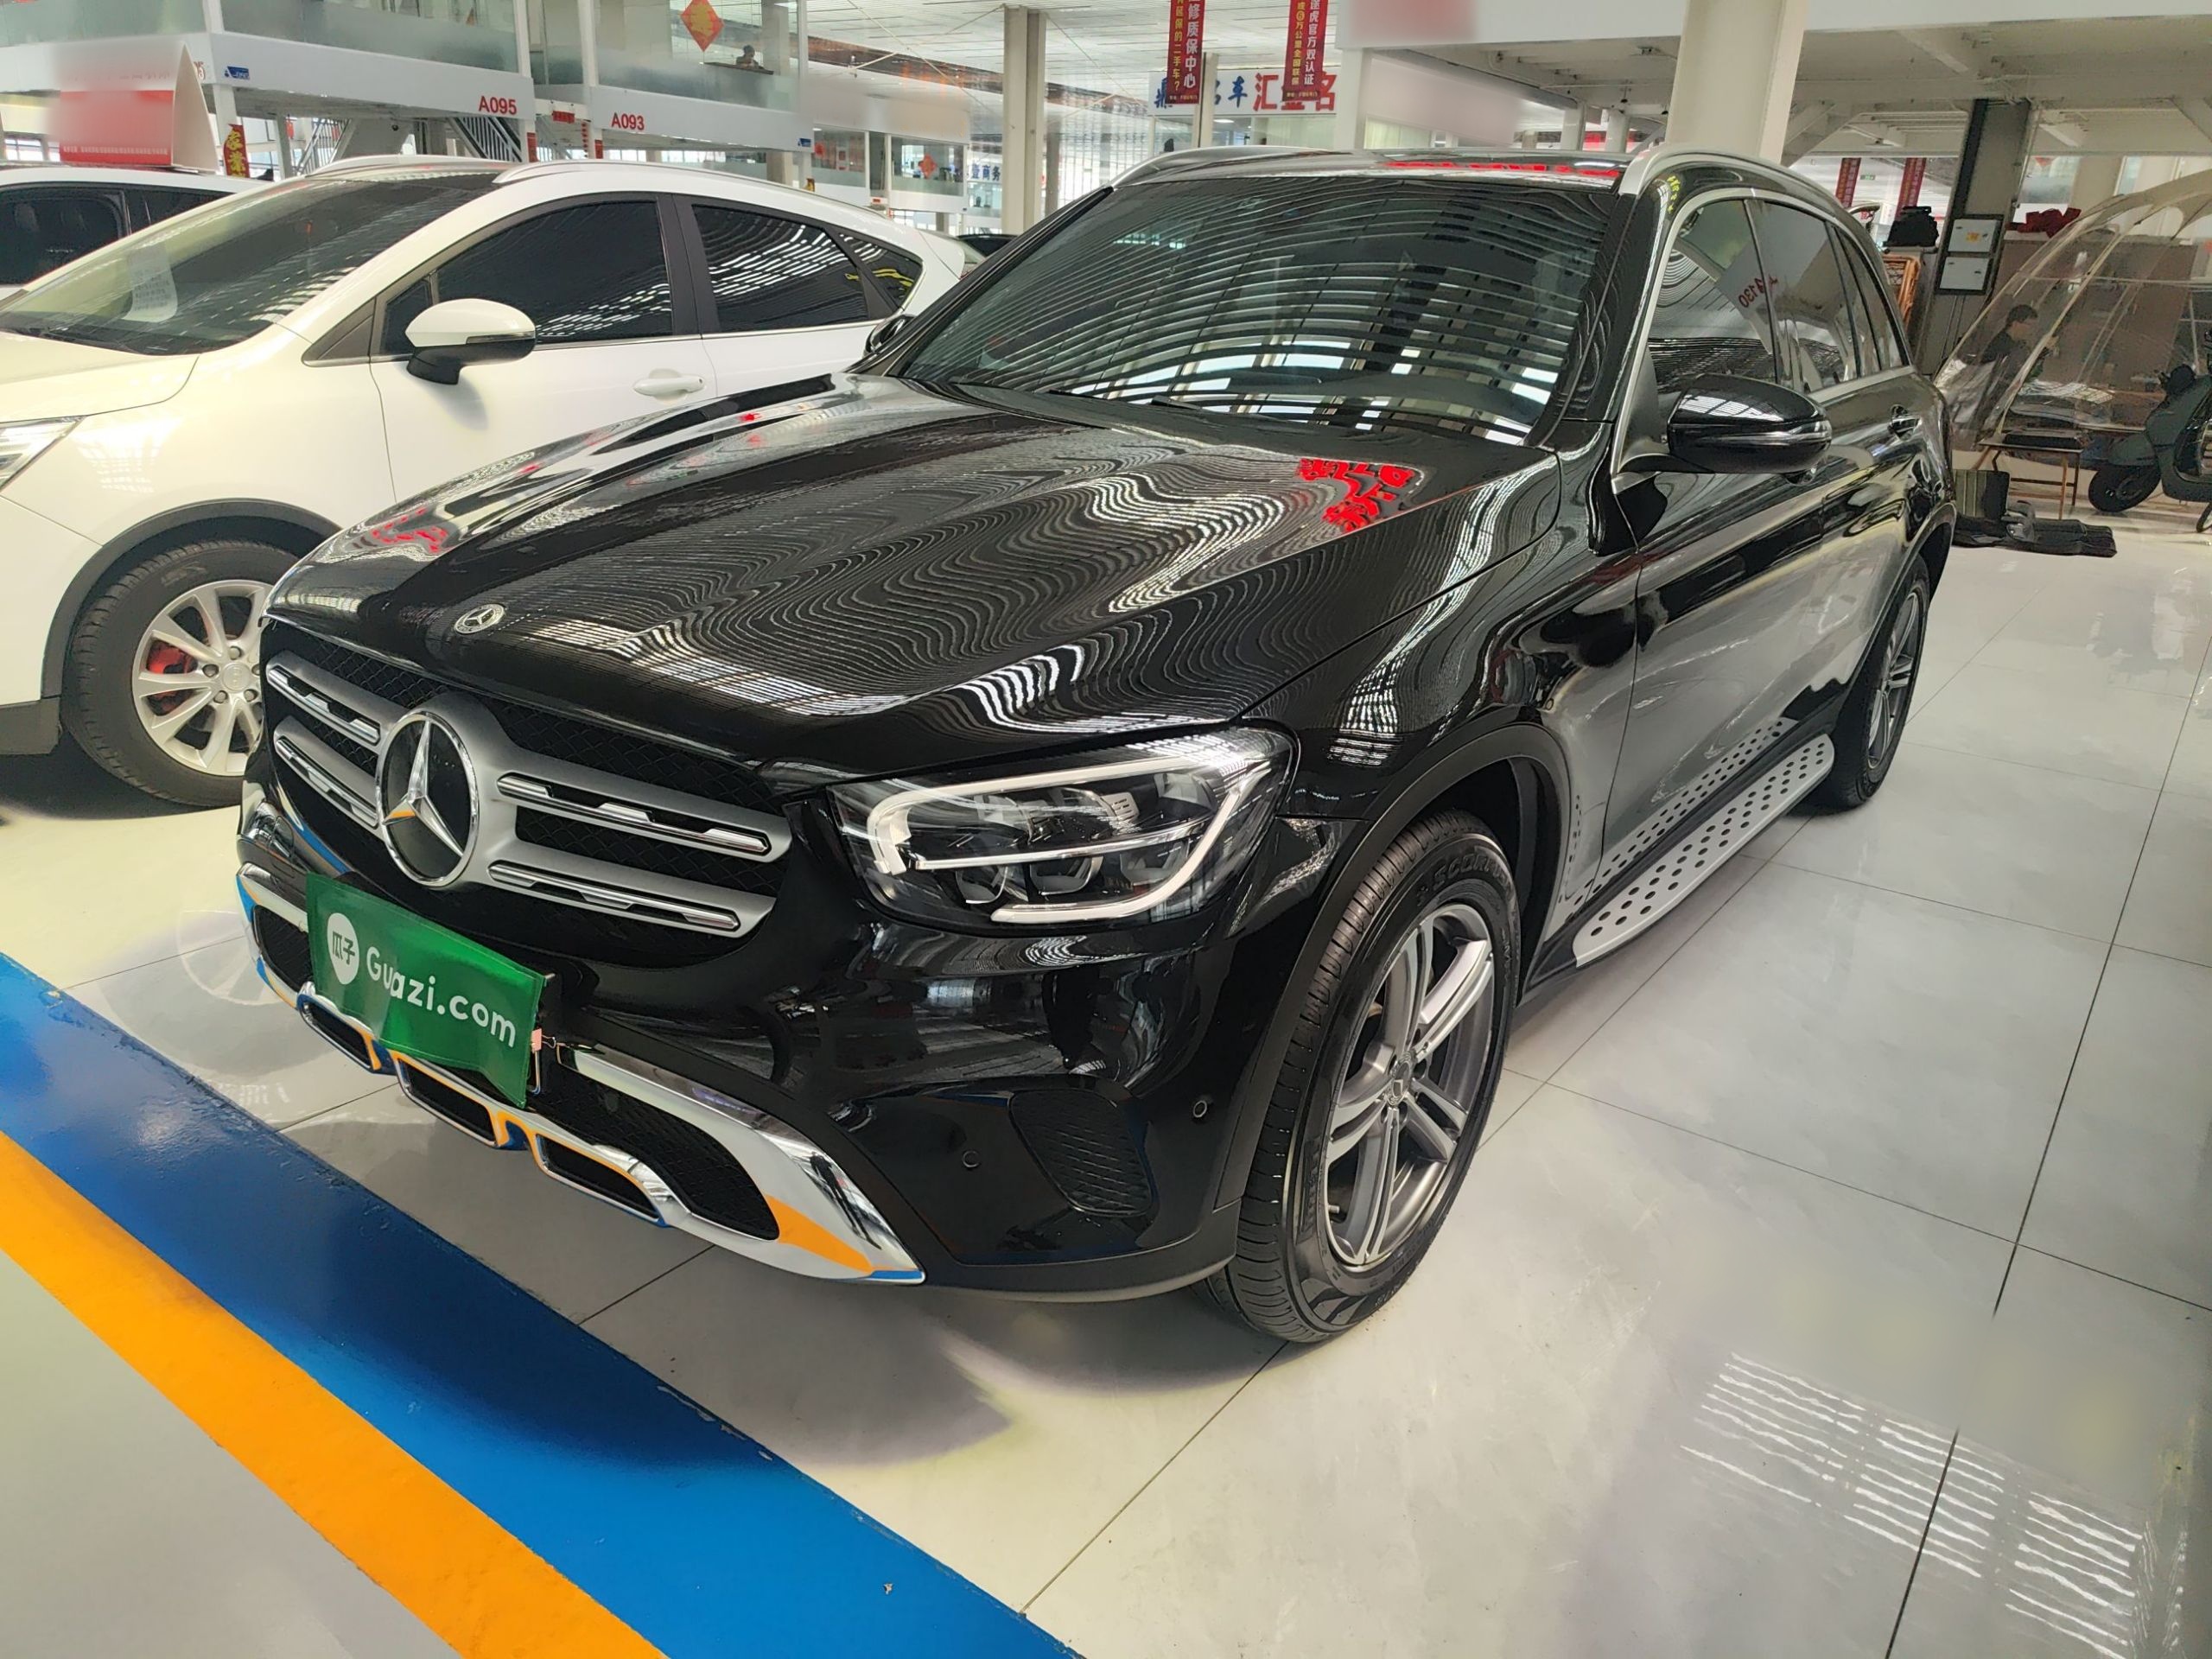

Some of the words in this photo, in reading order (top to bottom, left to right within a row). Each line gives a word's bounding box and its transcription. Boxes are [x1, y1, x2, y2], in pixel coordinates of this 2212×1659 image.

[1184, 0, 1200, 88] 修质保中心
[479, 96, 517, 115] A095
[611, 112, 645, 130] A093
[332, 931, 356, 966] 瓜子
[365, 945, 517, 1048] Guazi.com
